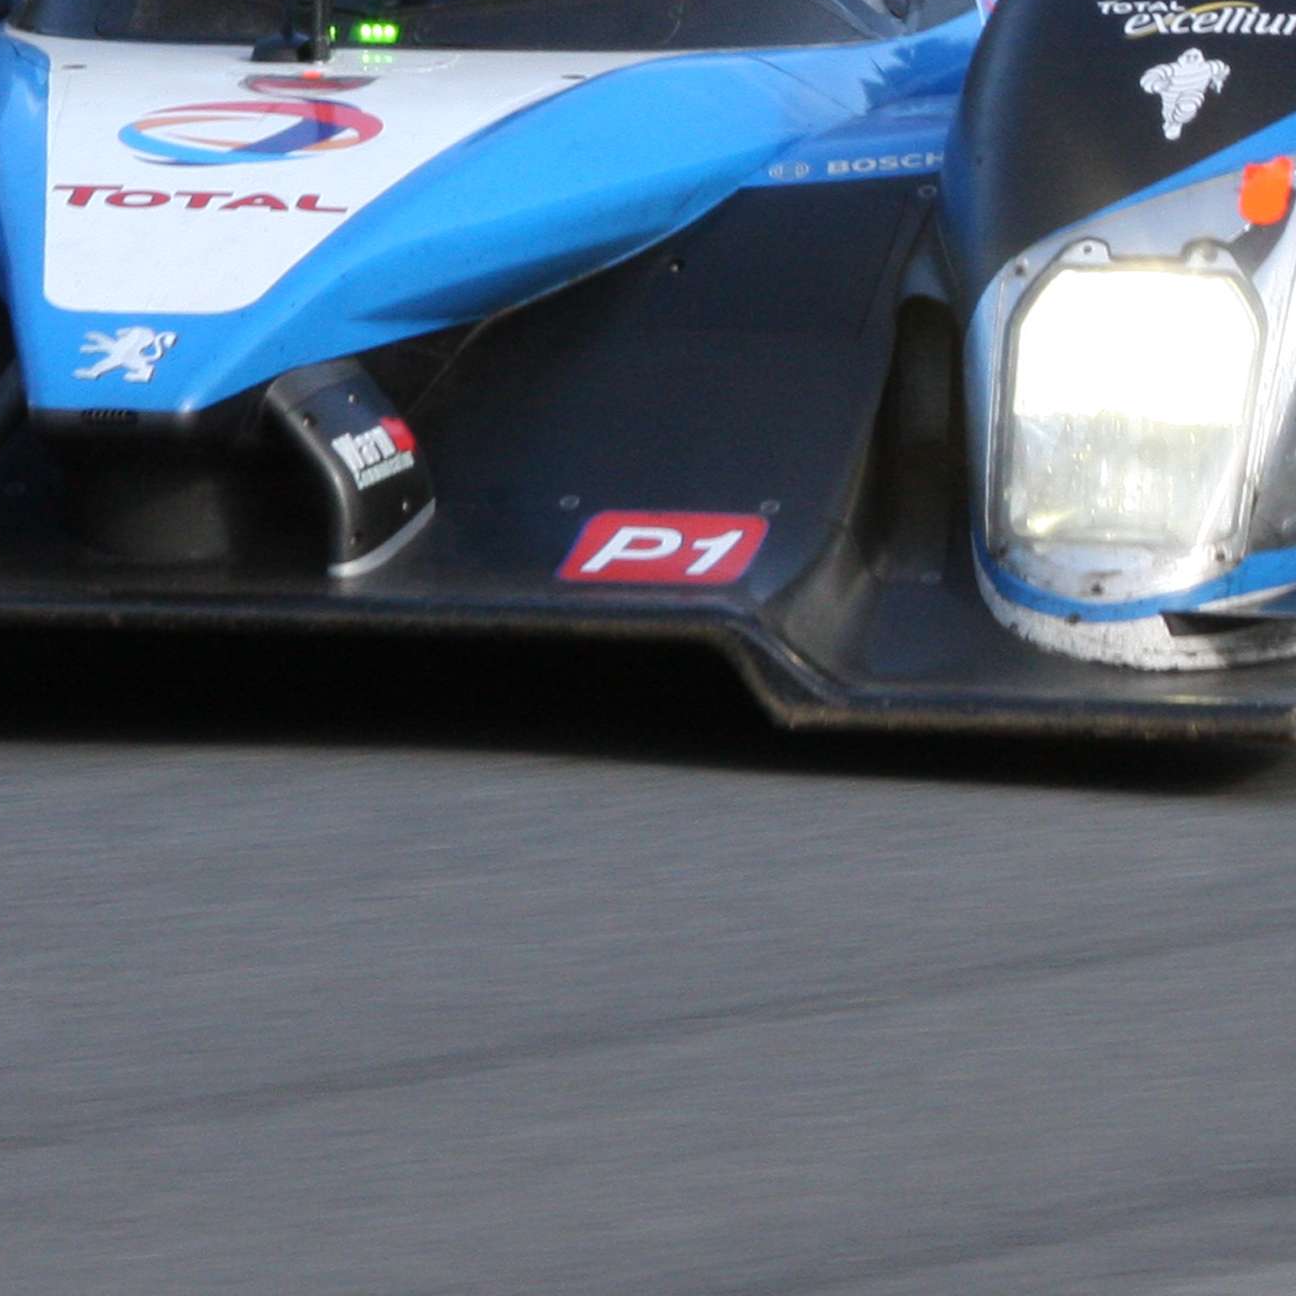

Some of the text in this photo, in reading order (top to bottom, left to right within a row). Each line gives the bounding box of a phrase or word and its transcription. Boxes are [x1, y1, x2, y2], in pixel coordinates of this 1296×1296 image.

[1097, 0, 1186, 14] TOTAL
[826, 152, 945, 176] BOSCH
[52, 184, 349, 212] TOTAL
[579, 525, 744, 576] P1
